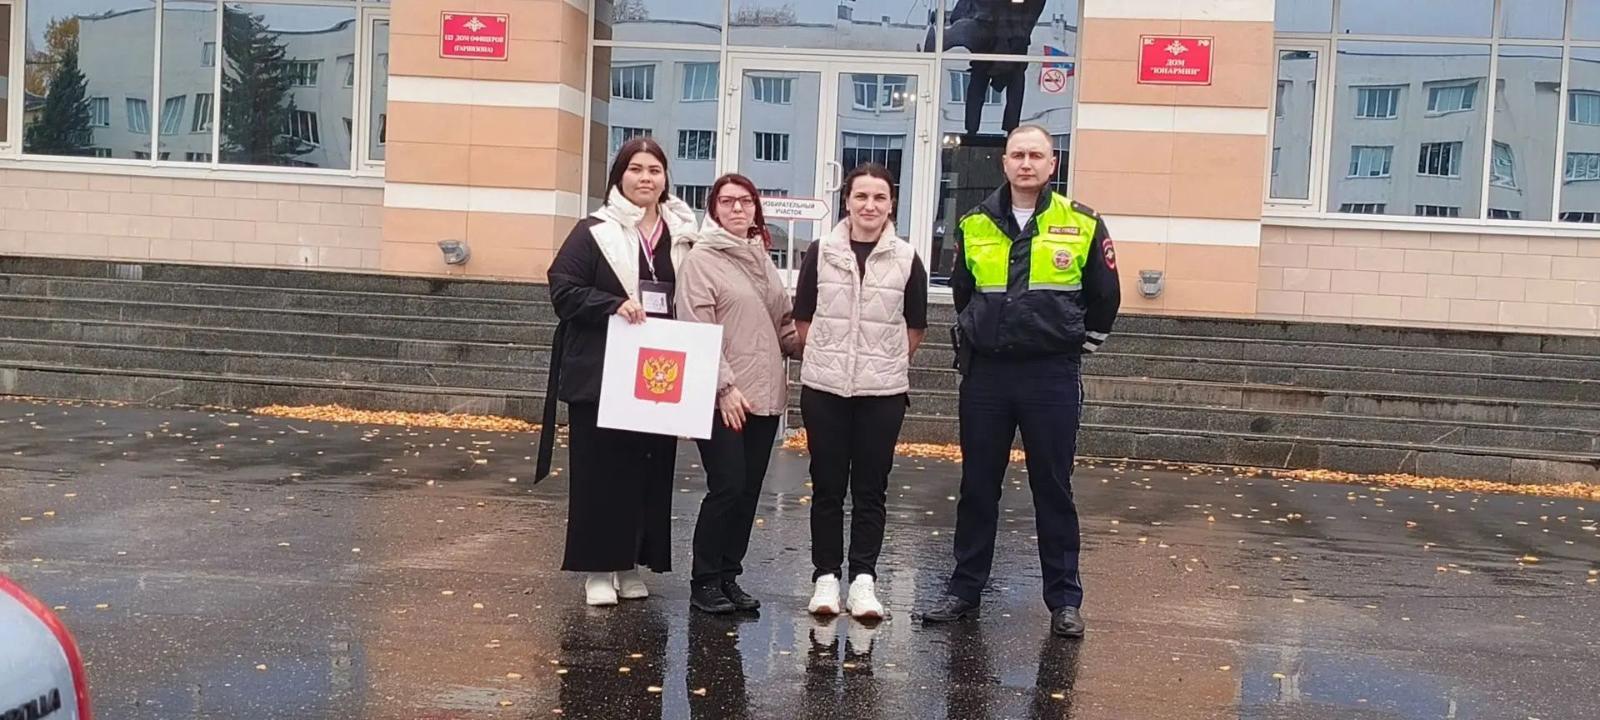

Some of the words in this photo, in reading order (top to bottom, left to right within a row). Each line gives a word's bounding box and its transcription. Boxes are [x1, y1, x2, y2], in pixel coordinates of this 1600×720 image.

[455, 34, 470, 42] ДОМ
[470, 35, 504, 43] ОФИЦЕРОВ
[1198, 39, 1210, 47] РФ
[1166, 59, 1185, 67] ДОМ
[763, 200, 815, 209] ИЗБИРАТЕЛЬНЫЙ
